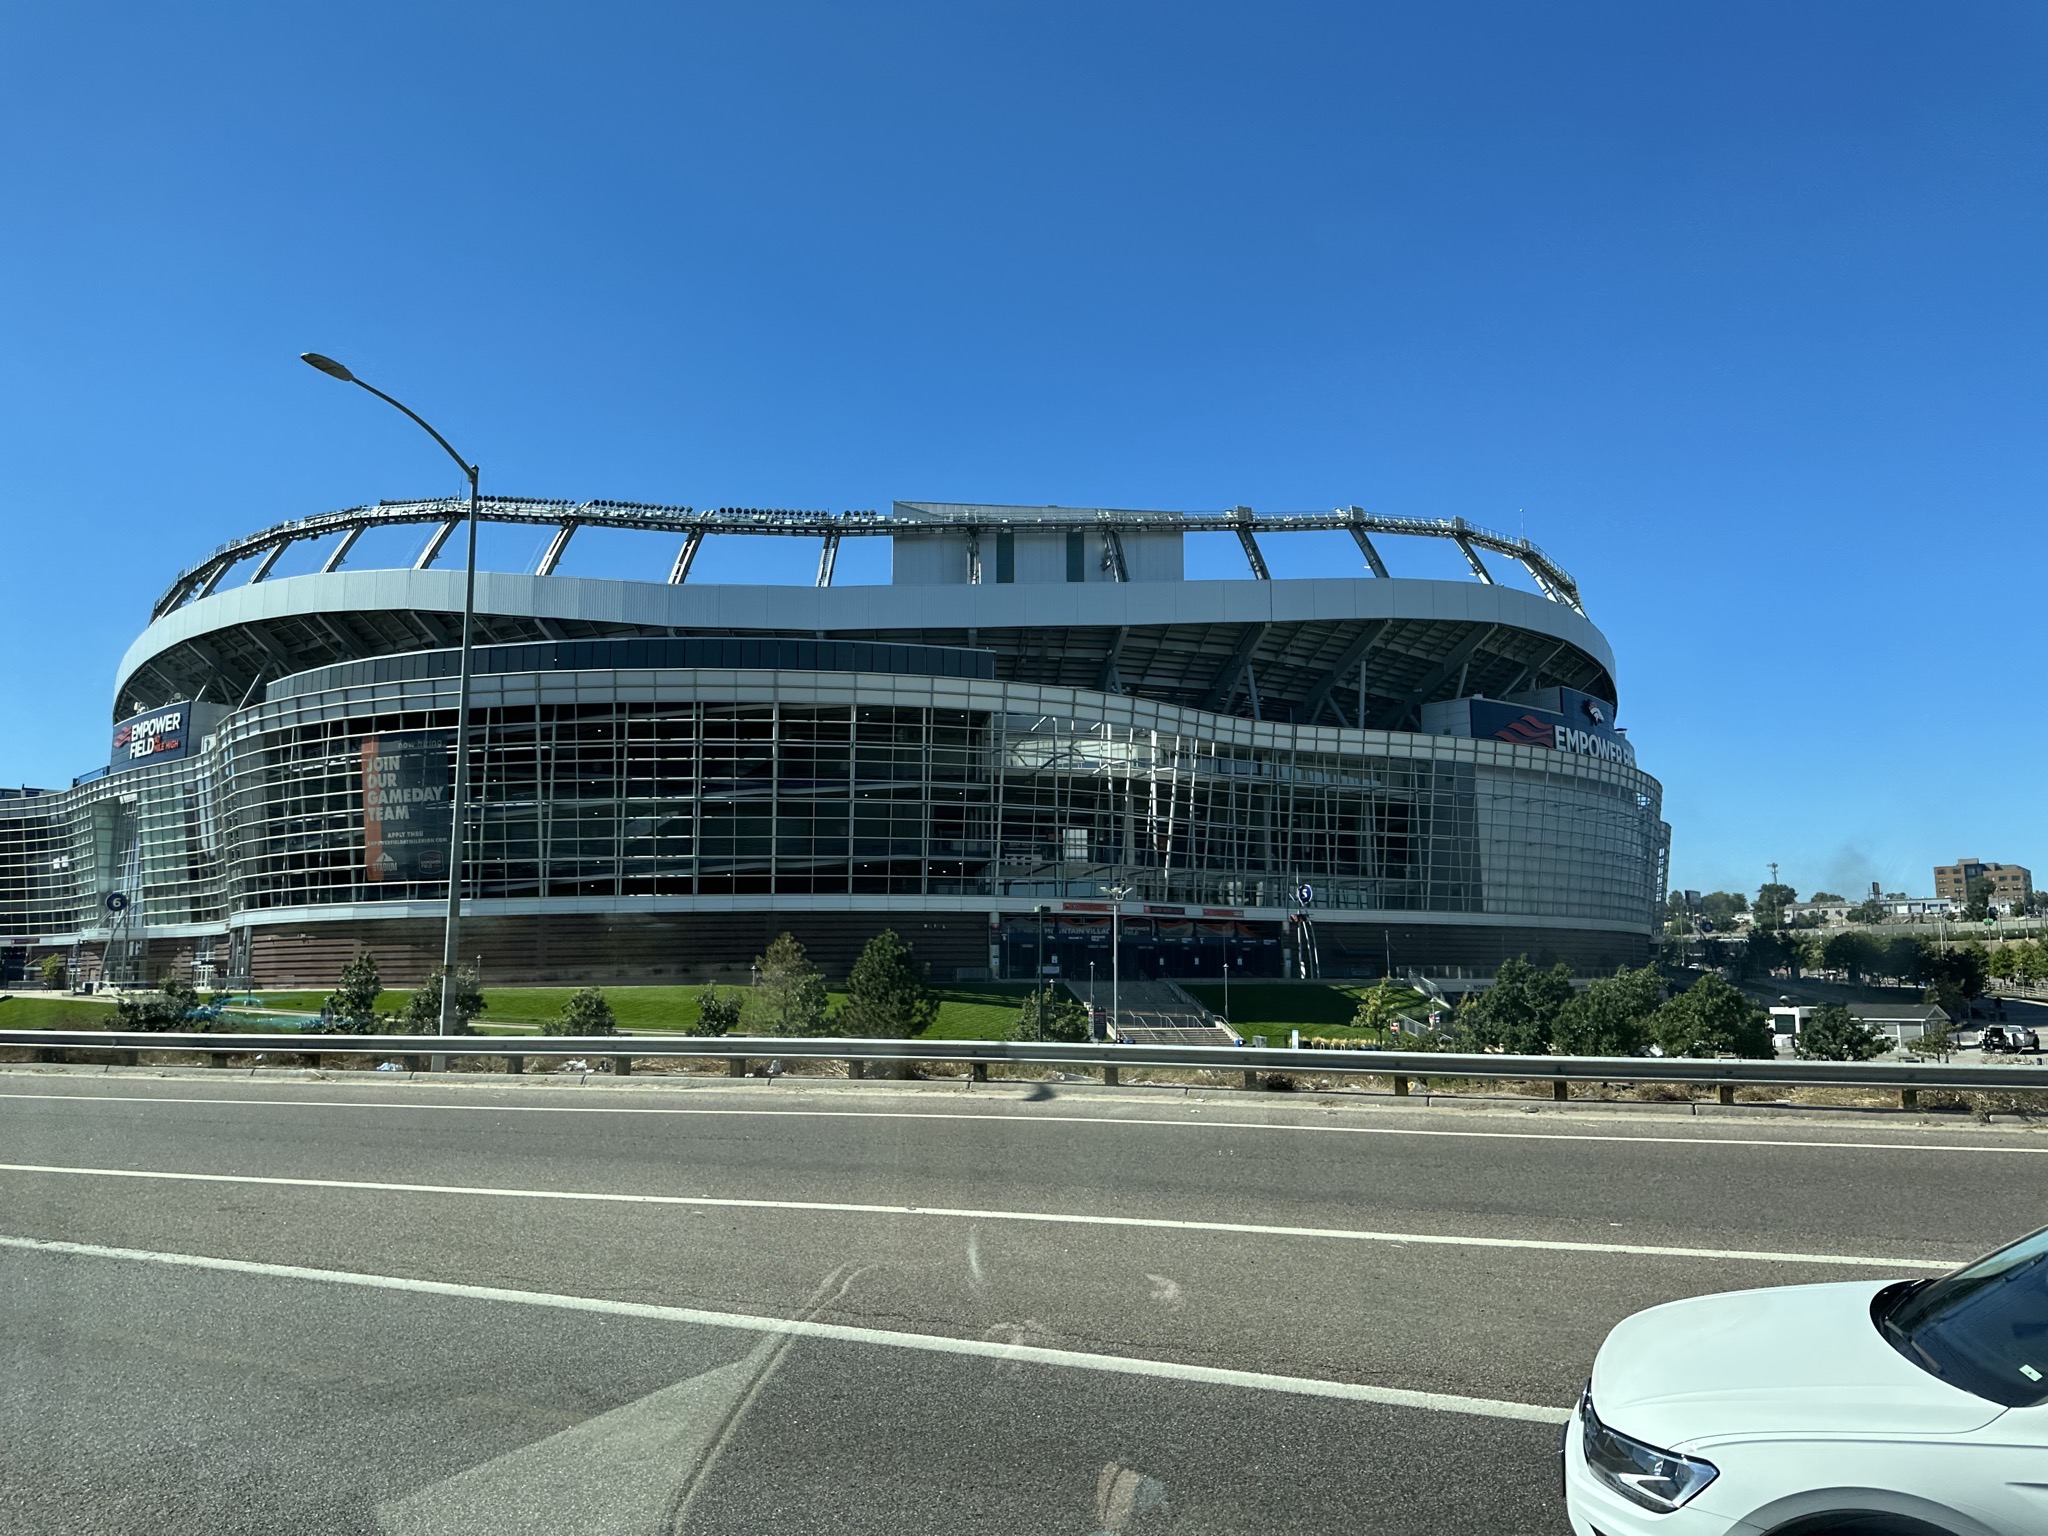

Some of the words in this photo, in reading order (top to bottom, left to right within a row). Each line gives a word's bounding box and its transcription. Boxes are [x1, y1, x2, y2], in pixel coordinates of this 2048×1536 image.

[131, 712, 181, 742] EMPOWER
[129, 737, 155, 760] FIELD
[1554, 724, 1622, 764] EMPOWER
[366, 756, 401, 773] JOIN
[366, 773, 398, 789] OUR
[367, 786, 444, 805] GAMEDAY
[367, 805, 410, 821] TEAM
[407, 830, 424, 838] THRU
[372, 862, 398, 872] STADIUM
[112, 897, 121, 908] 6
[1044, 927, 1084, 935] MONTAIN
